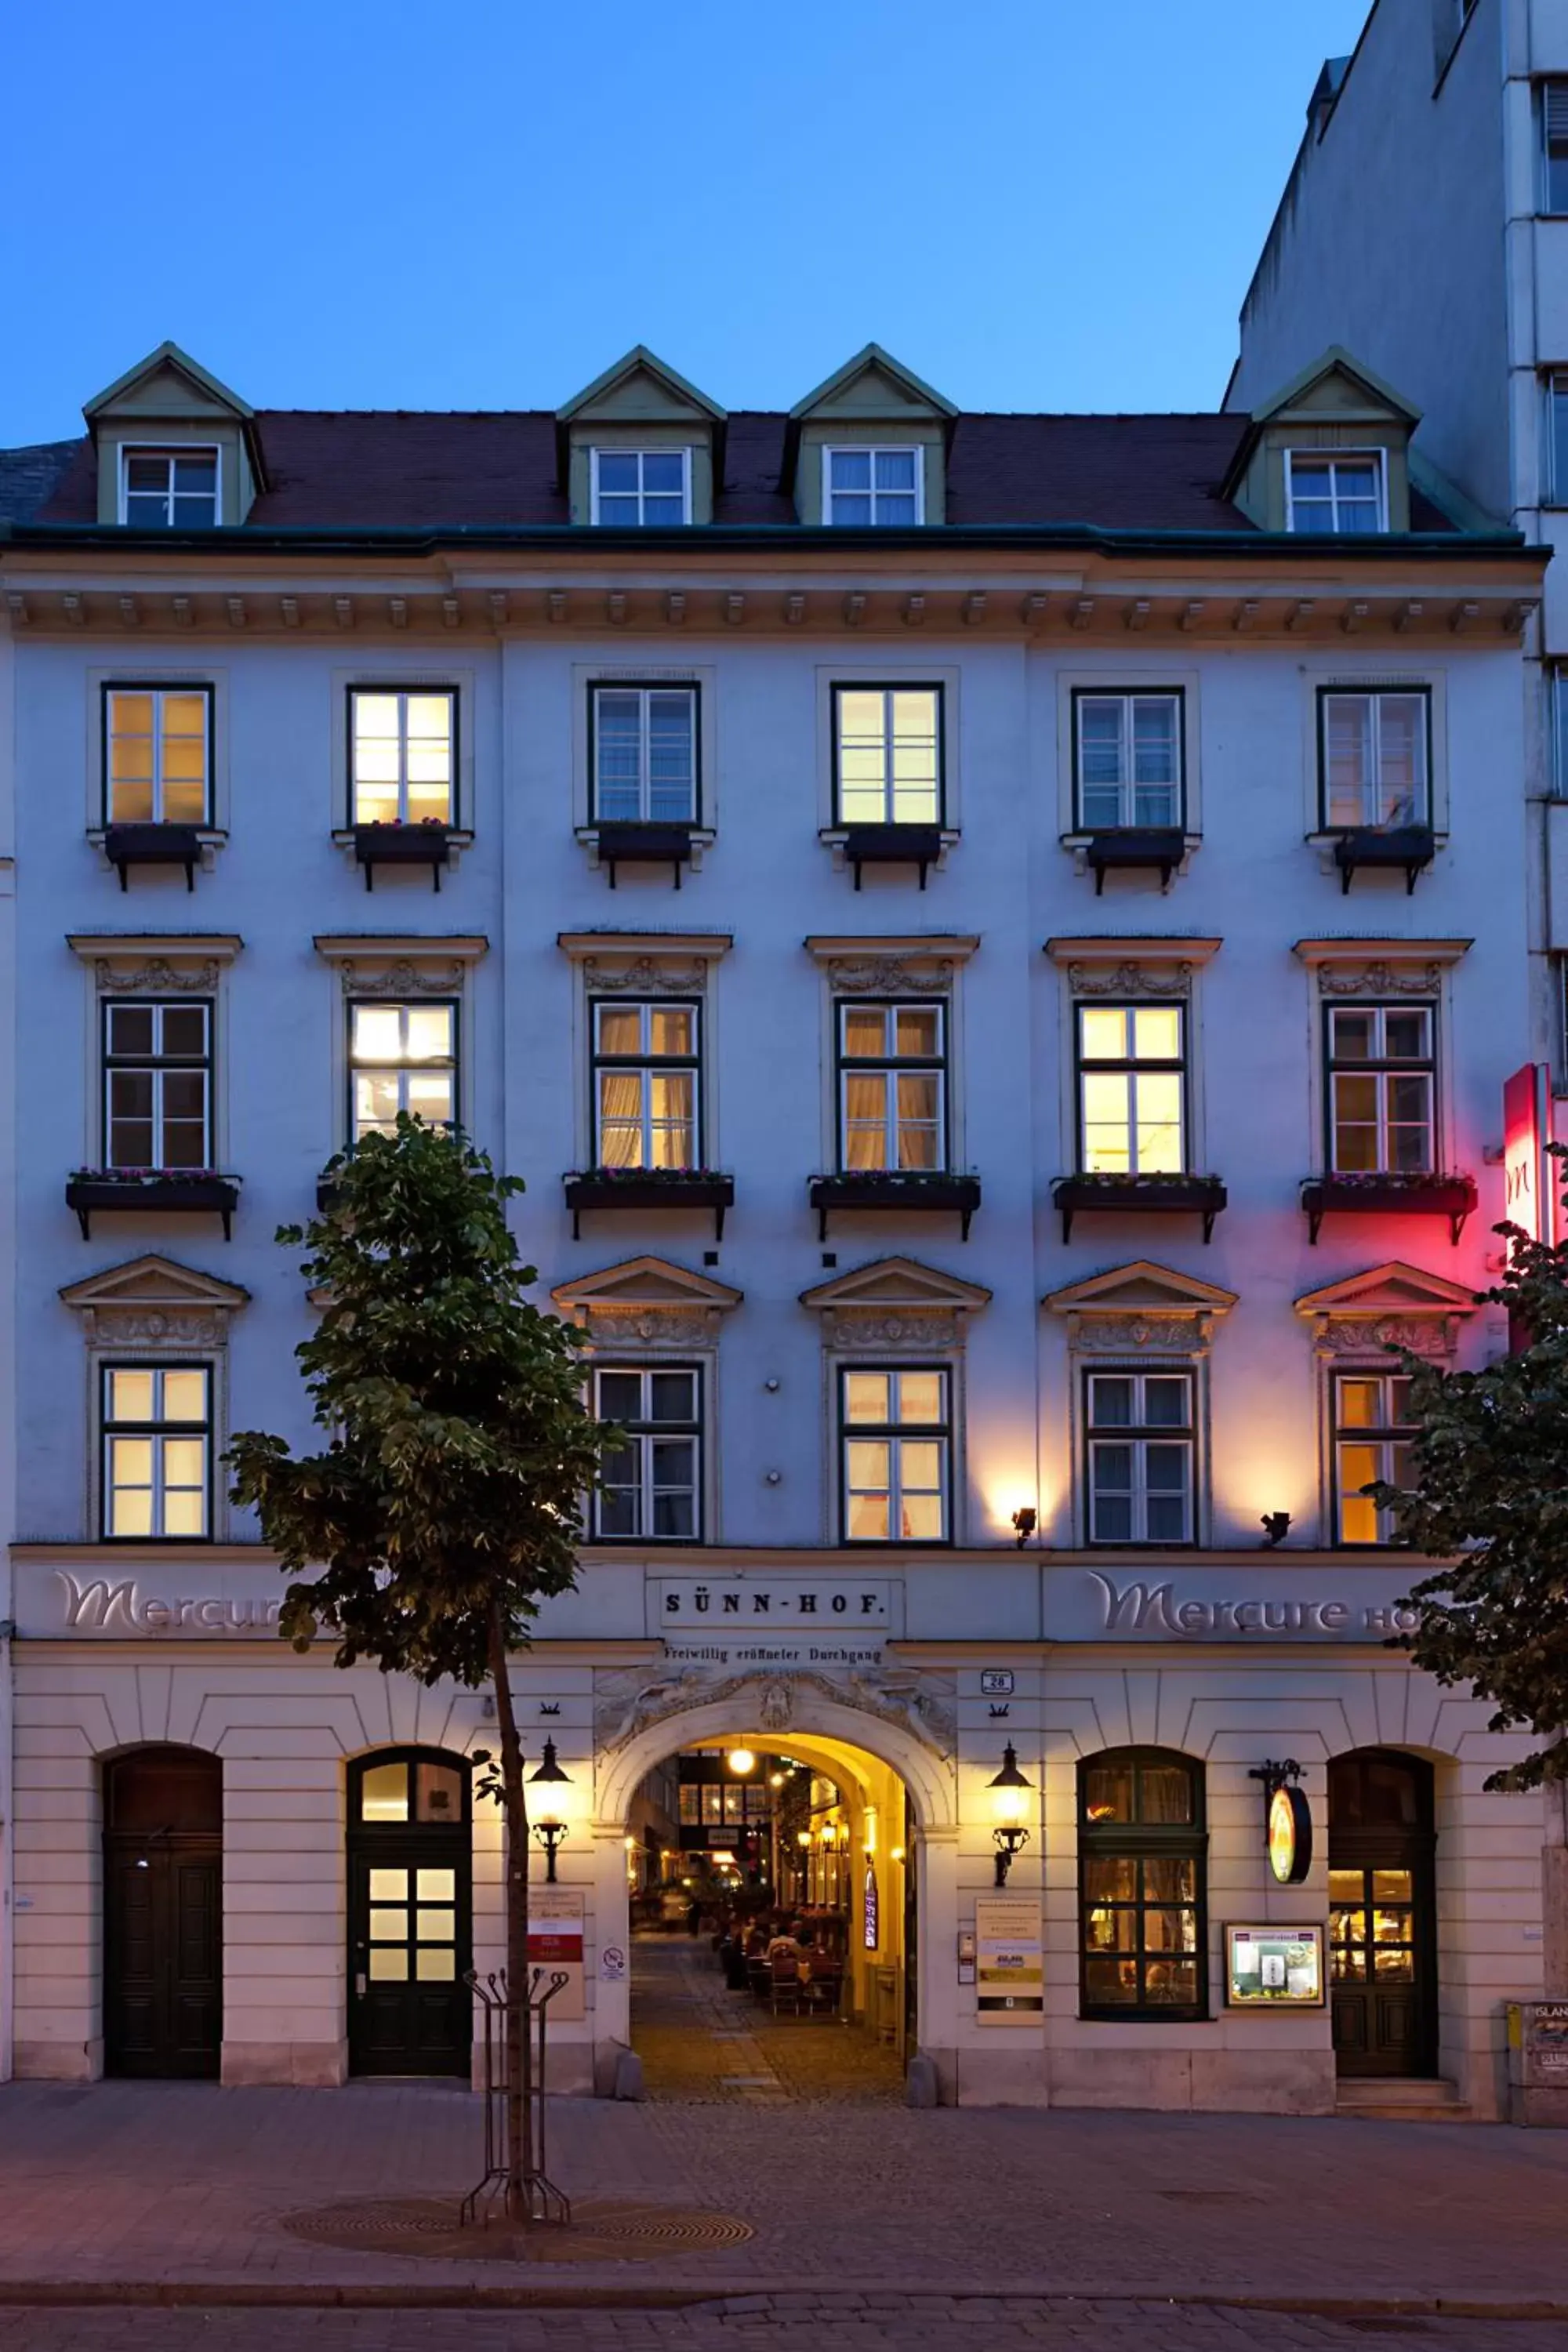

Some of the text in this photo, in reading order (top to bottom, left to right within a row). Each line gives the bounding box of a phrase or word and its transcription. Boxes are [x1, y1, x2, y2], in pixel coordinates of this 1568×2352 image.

[55, 1570, 281, 1635] Mercur
[666, 1586, 885, 1613] SÜNN-HOF.
[1090, 1570, 1348, 1636] Mercure
[663, 1647, 728, 1664] Freiwillig
[809, 1648, 882, 1664] Durchgang
